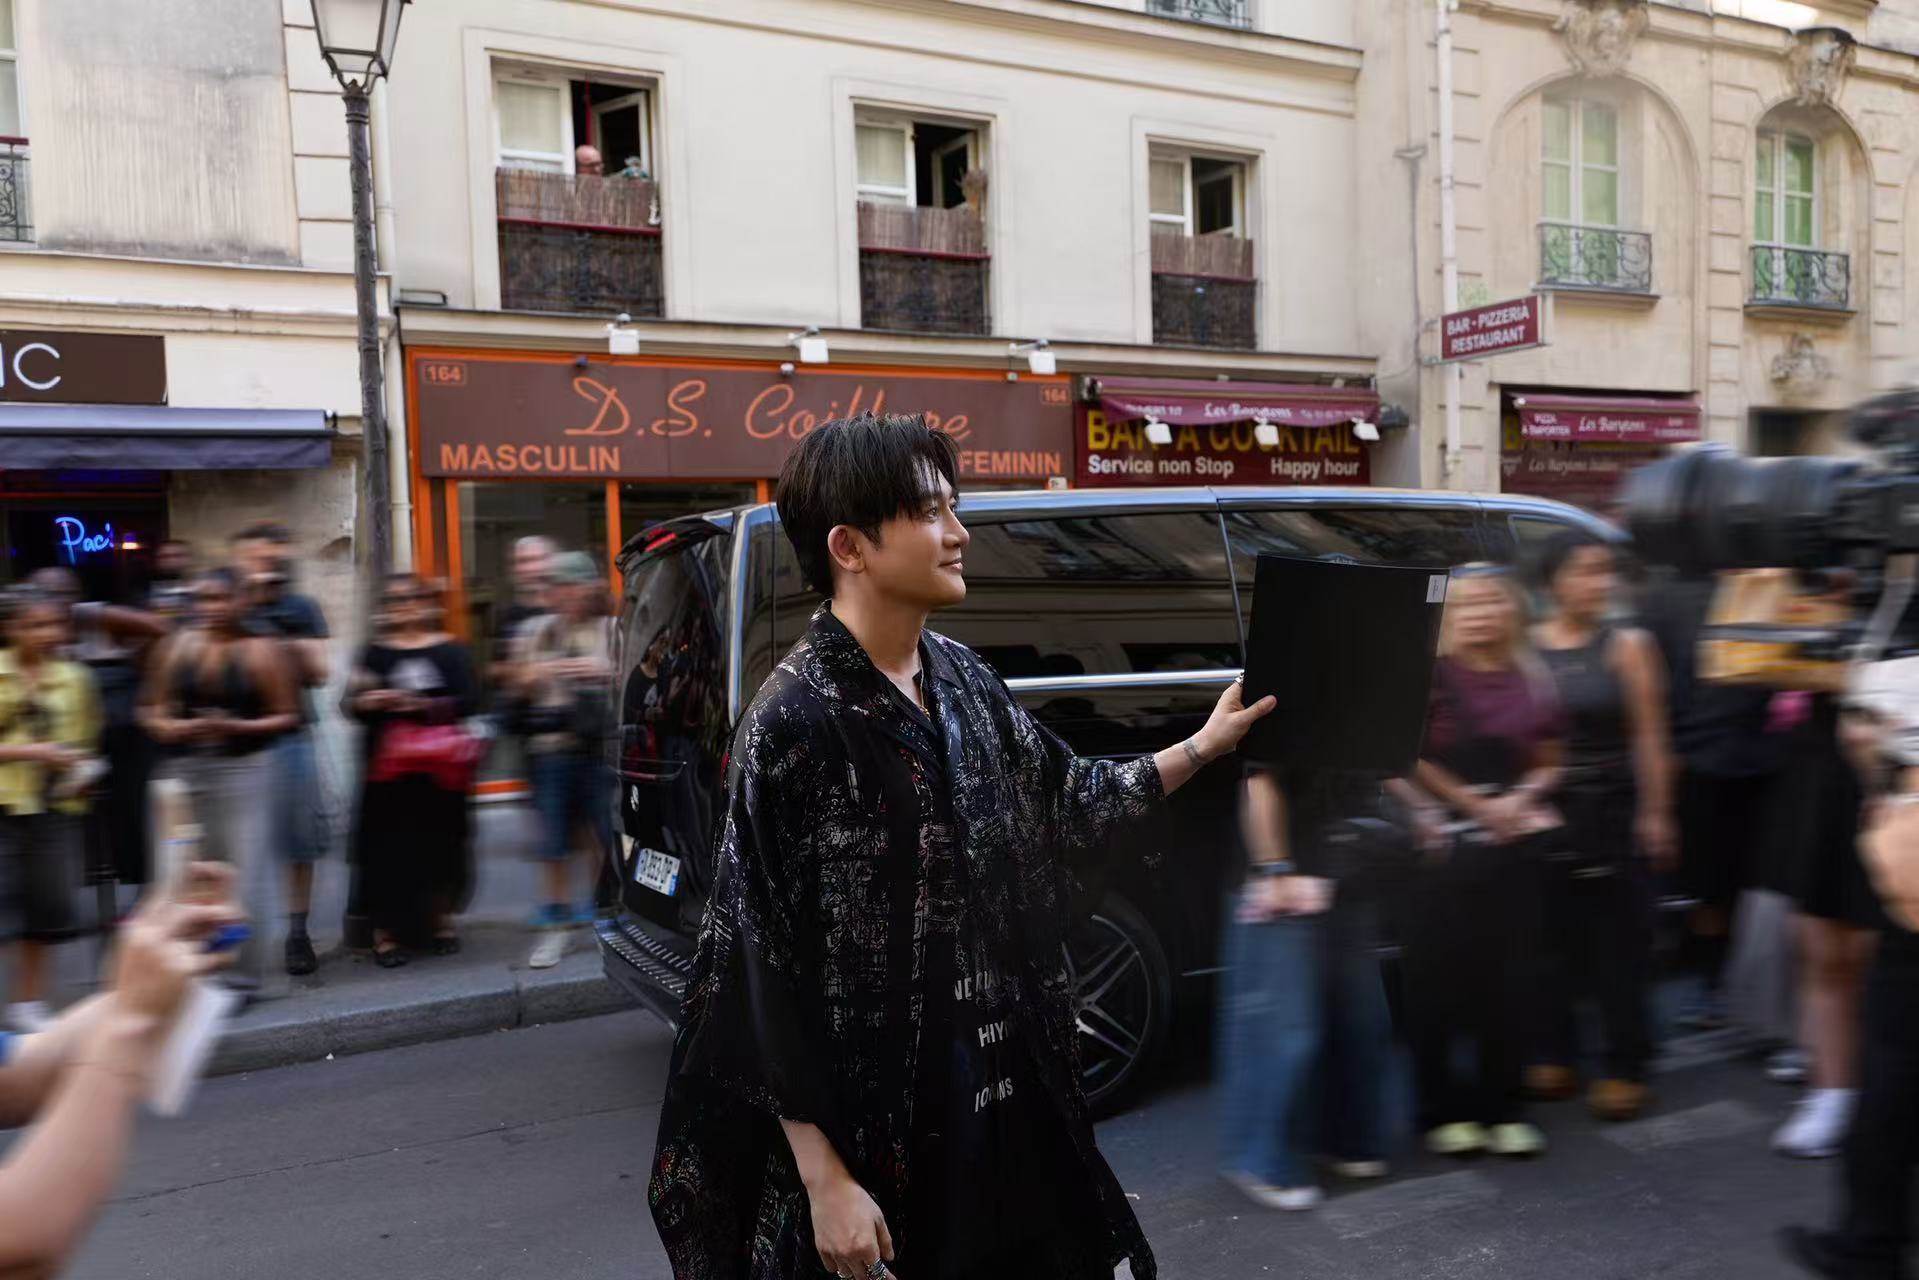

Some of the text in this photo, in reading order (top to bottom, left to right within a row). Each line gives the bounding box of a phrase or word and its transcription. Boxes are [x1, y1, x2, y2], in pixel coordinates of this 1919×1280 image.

[1446, 304, 1530, 336] BAR PIZZERIA
[1451, 325, 1525, 354] RESTAURANT
[427, 365, 461, 381] 164
[440, 443, 621, 472] MASCULIN
[958, 450, 1062, 475] FEMININ
[1087, 454, 1360, 480] Service non Stop Happy hour
